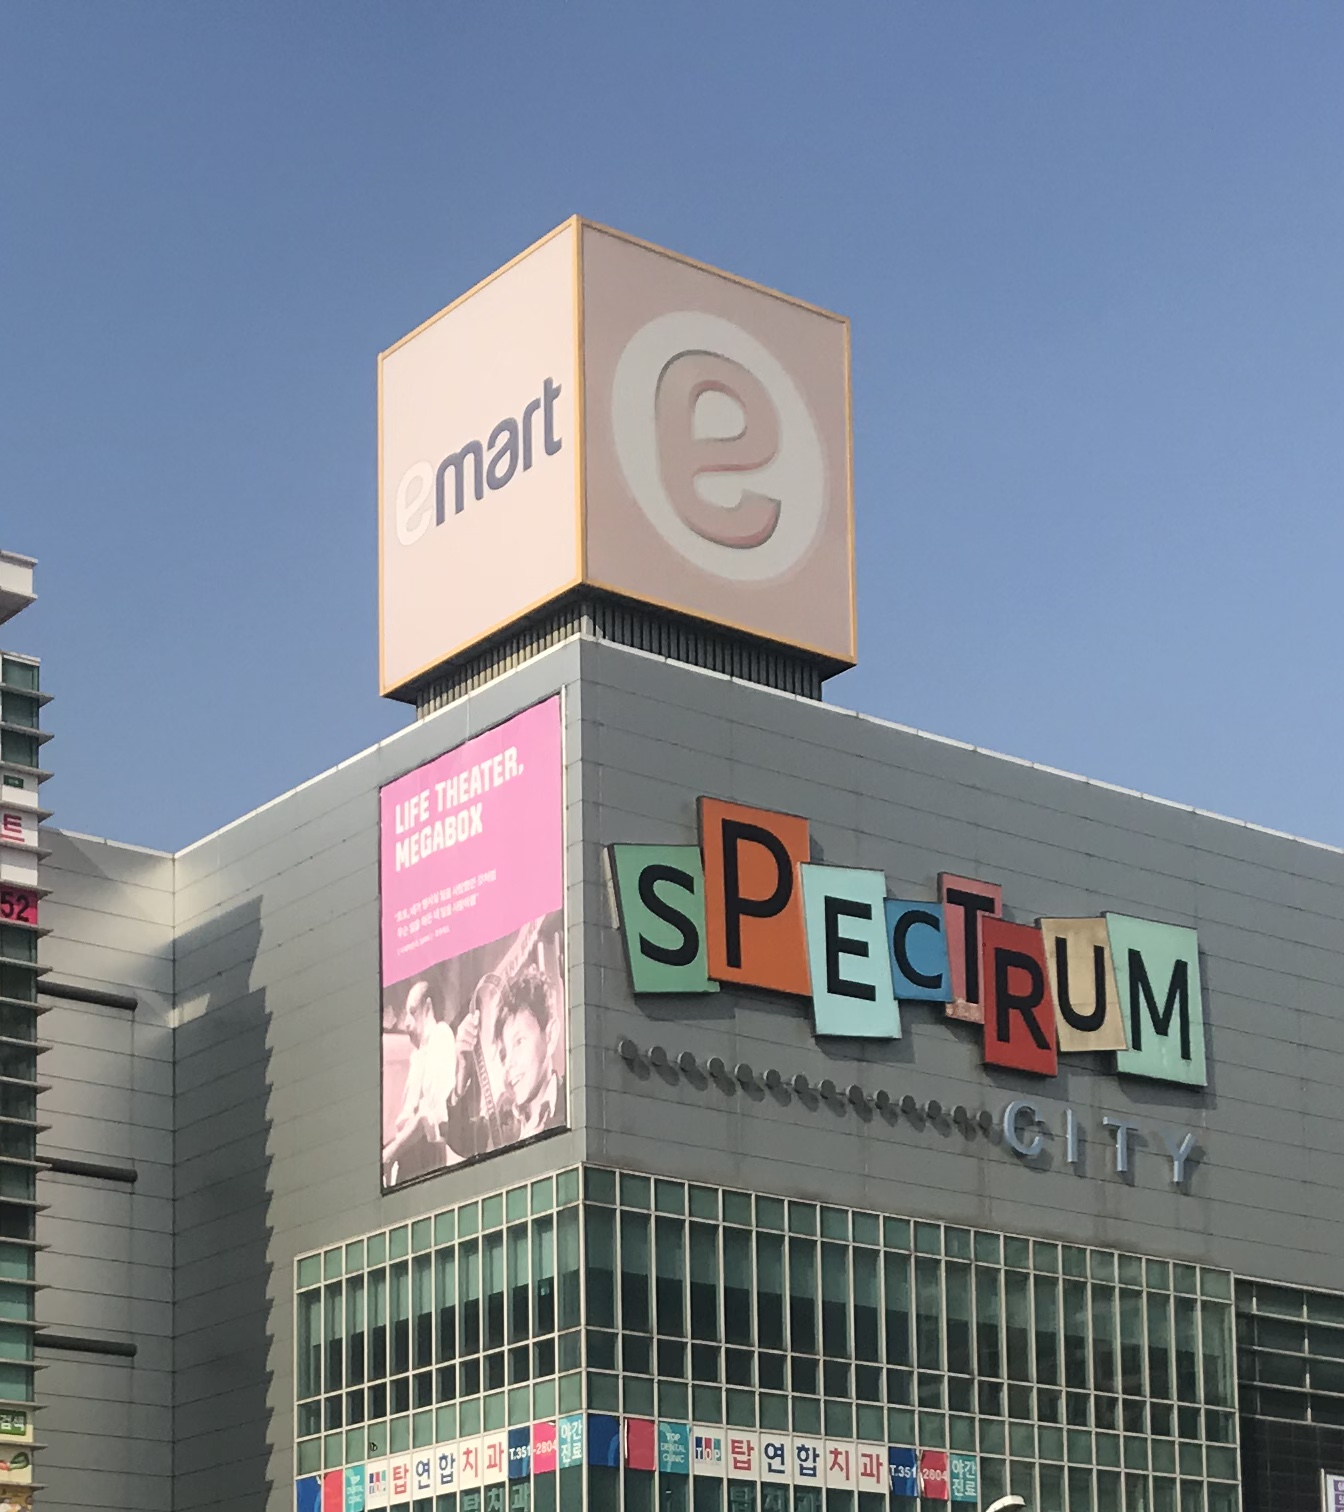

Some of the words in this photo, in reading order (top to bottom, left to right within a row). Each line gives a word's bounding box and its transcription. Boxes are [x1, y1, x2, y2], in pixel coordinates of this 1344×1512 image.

[395, 377, 563, 547] emart
[654, 349, 782, 550] e
[394, 788, 431, 835] LIFE
[435, 745, 525, 812] THEATER,
[394, 803, 484, 873] MEGABOX
[638, 818, 1192, 1061] SPECTRUM
[1003, 1100, 1196, 1184] CITY
[560, 1421, 582, 1445] 야간
[560, 1441, 583, 1467] 진료
[951, 1460, 976, 1480] 야간
[951, 1478, 977, 1499] 진료
